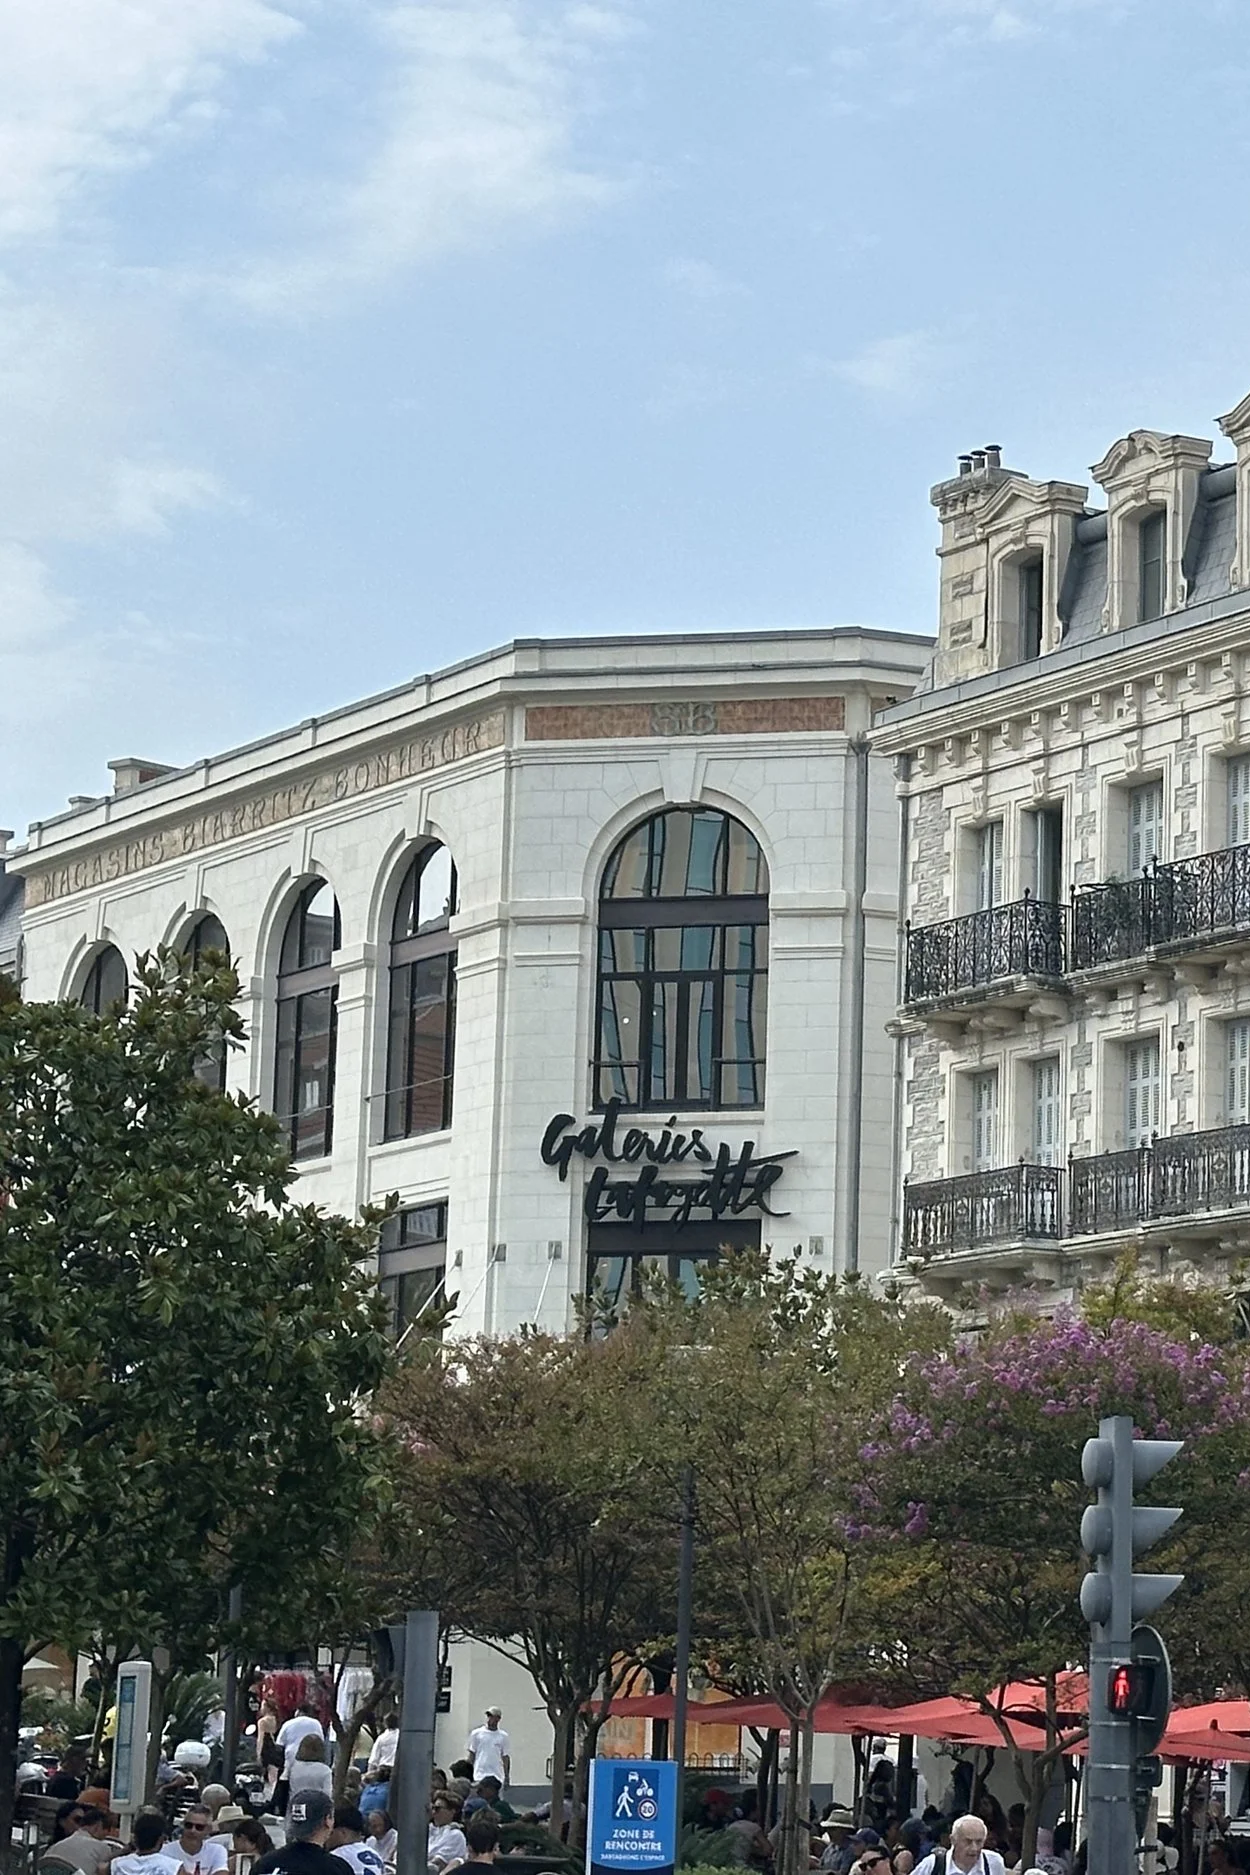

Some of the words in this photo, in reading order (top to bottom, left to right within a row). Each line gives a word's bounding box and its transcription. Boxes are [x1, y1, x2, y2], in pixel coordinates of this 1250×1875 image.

[42, 832, 165, 900] MAGASINS
[182, 777, 318, 853] BIARRITZ
[334, 720, 481, 800] BONHEUR
[540, 1096, 713, 1182] Galeries
[584, 1140, 800, 1234] Lafayette
[612, 1828, 640, 1839] ZONE
[642, 1829, 655, 1839] DE
[642, 1806, 653, 1814] 20
[604, 1840, 662, 1852] RENCONTRE
